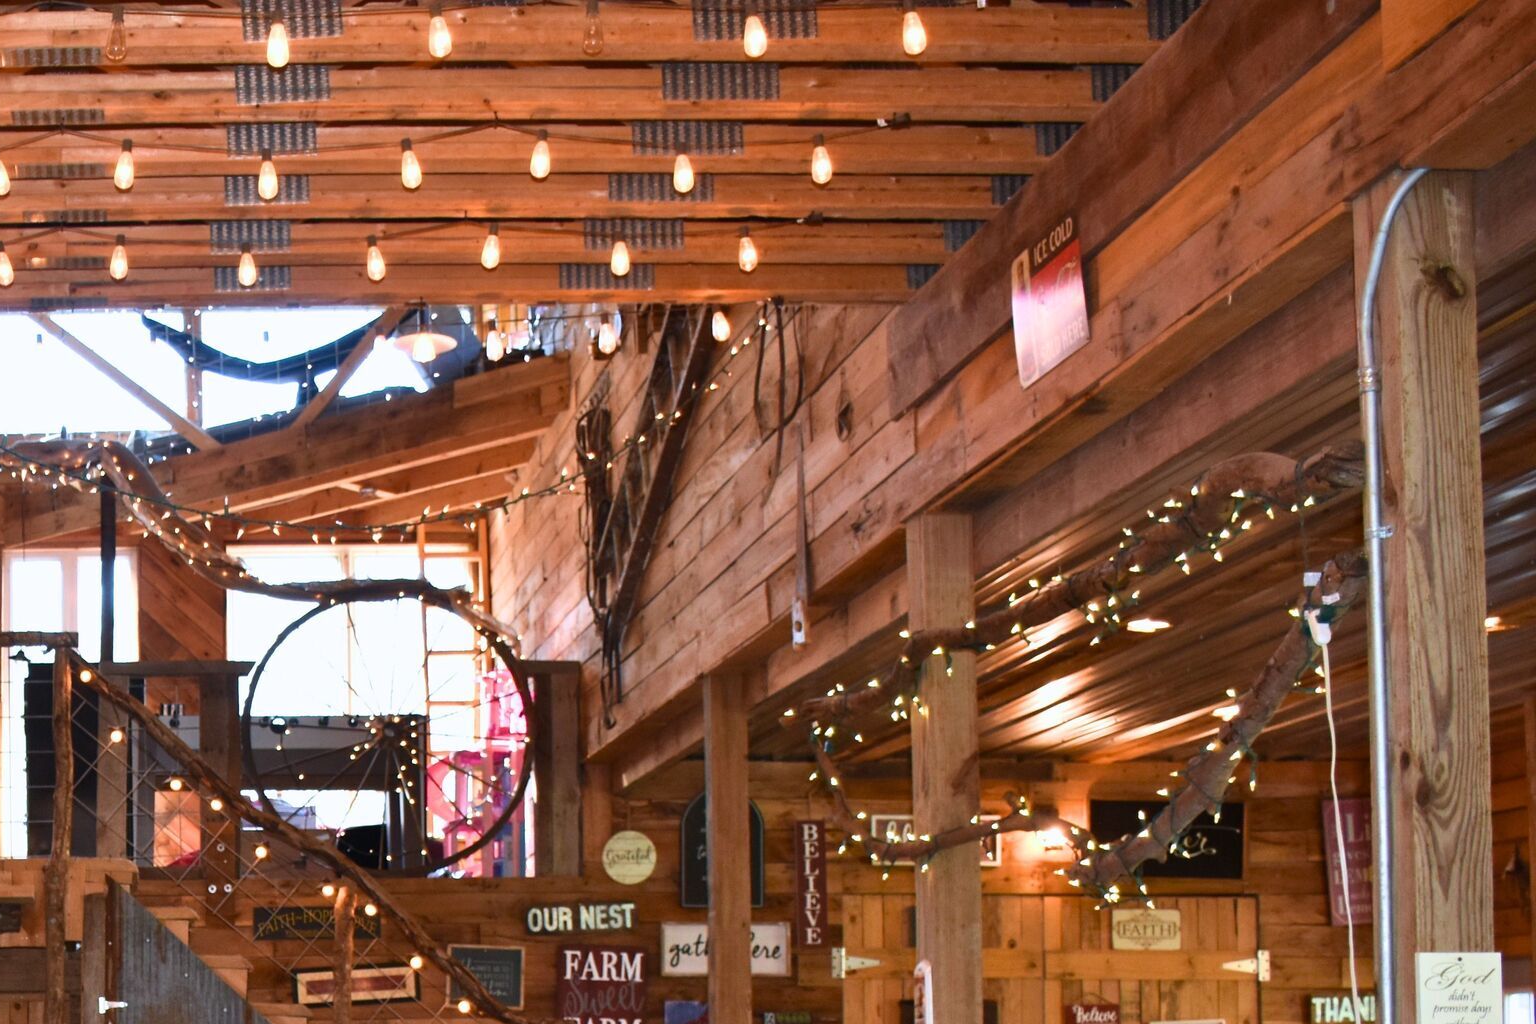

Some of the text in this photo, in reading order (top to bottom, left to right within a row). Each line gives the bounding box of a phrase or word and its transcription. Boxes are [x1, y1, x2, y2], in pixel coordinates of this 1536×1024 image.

[1033, 217, 1074, 267] ICE COLD
[605, 847, 653, 870] Grateful
[802, 823, 822, 945] BELIEVE
[527, 903, 637, 932] OUR NEST
[1121, 922, 1173, 937] FAITH
[564, 950, 644, 983] FARM
[1424, 962, 1496, 991] God
[566, 977, 645, 1016] Sweet
[1448, 988, 1476, 1001] didn't
[1072, 1004, 1118, 1024] Believe
[1433, 1001, 1492, 1018] promise days
